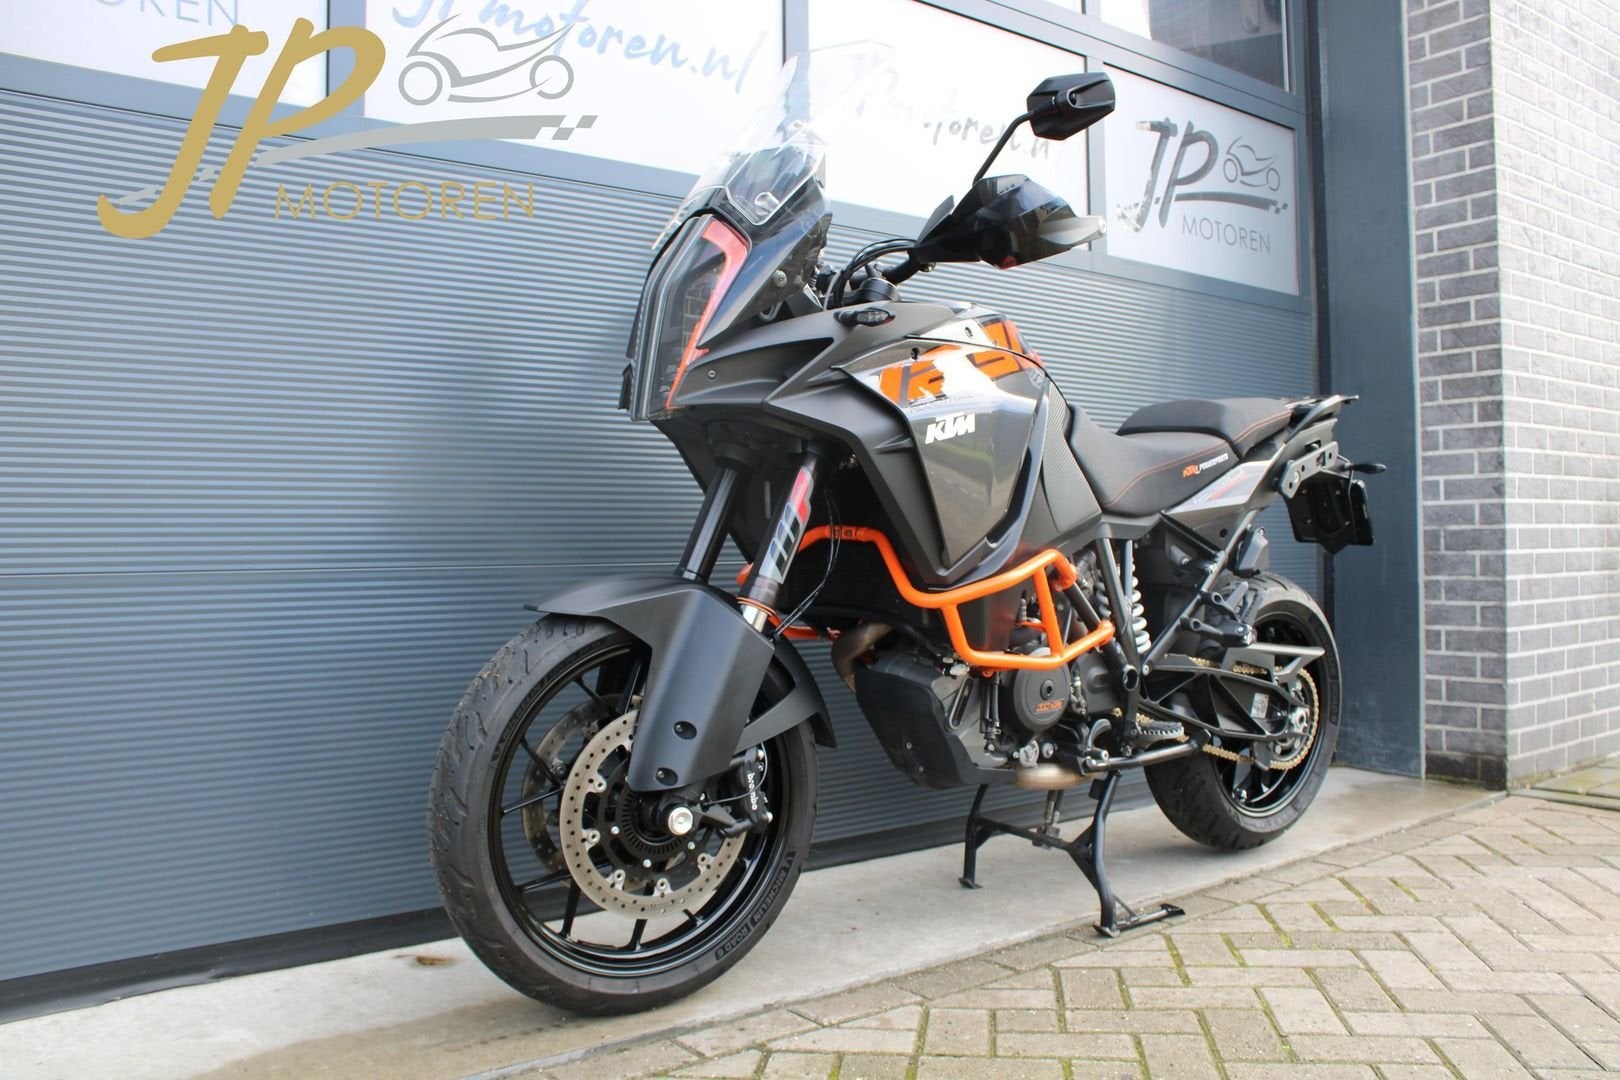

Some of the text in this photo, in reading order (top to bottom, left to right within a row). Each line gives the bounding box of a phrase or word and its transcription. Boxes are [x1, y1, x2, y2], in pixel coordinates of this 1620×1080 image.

[1116, 117, 1219, 233] JP
[1182, 213, 1272, 253] MOTOREN
[924, 412, 976, 445] KTM
[747, 772, 759, 810] brembo
[752, 869, 787, 923] MICHELIN
[724, 926, 750, 952] ROAD
